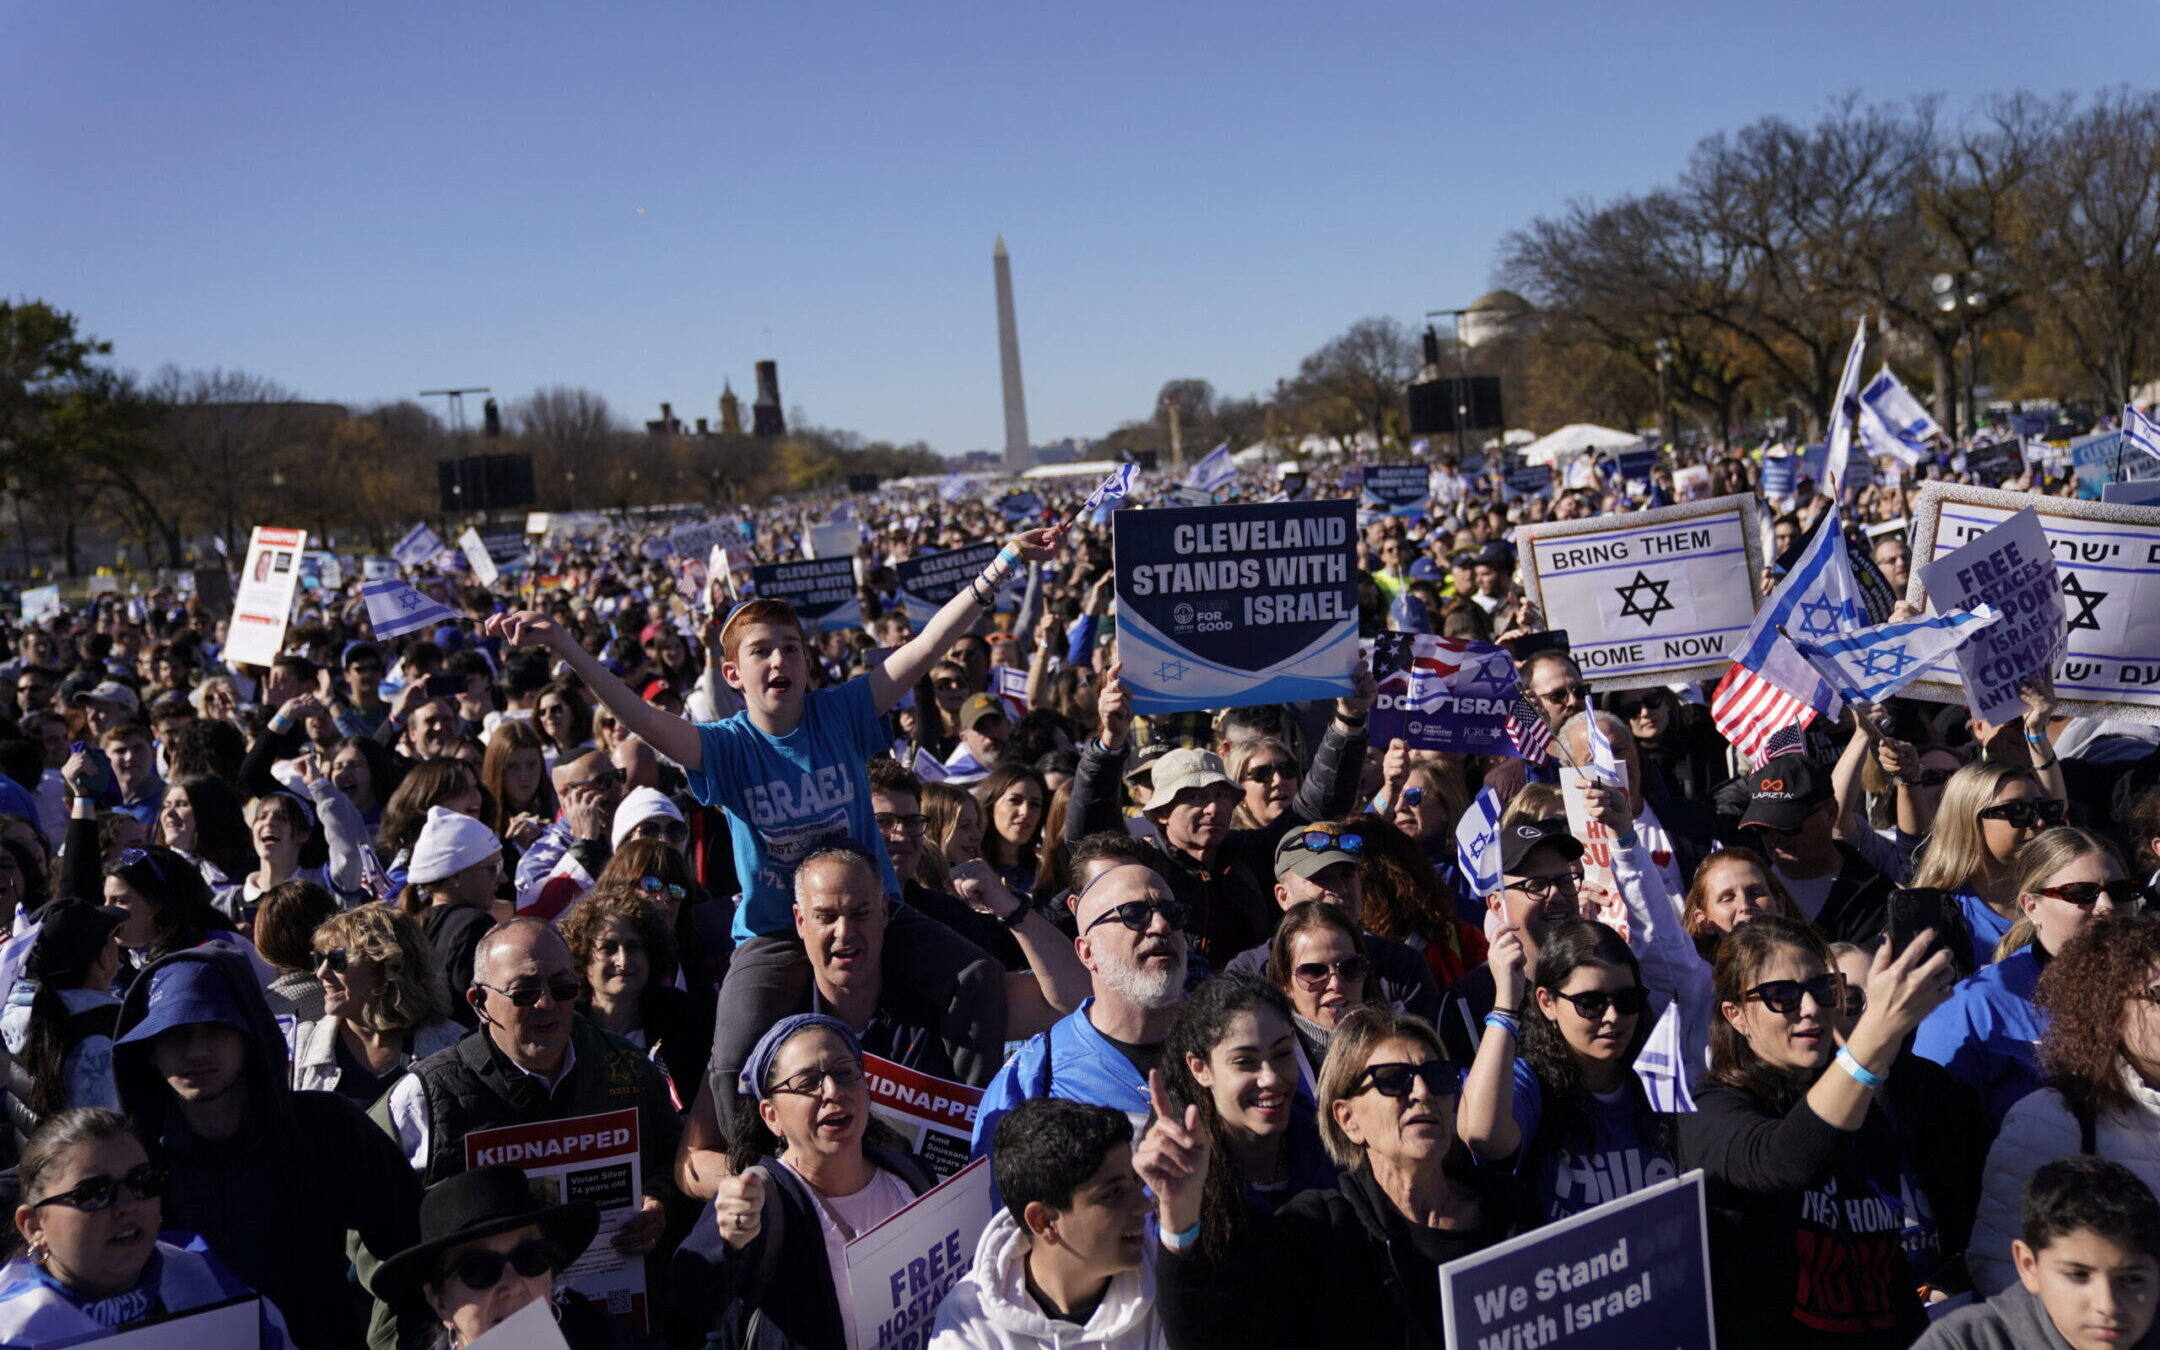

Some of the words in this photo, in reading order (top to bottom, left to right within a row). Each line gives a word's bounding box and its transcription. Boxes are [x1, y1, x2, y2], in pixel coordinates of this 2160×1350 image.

[1174, 517, 1346, 555] CLEVELAND
[1552, 542, 1629, 570] BRING
[1640, 530, 1711, 555] THEM
[776, 561, 851, 580] CLEVELAND
[921, 547, 997, 574] CLEVELAND
[1132, 559, 1260, 595] STANDS
[1266, 553, 1347, 587] WITH
[1956, 541, 2024, 594] FREE
[761, 579, 816, 596] STANDS
[816, 575, 852, 590] WITH
[906, 569, 962, 592] STANDS
[1197, 611, 1222, 622] FOR
[1244, 591, 1351, 626] ISRAEL
[1197, 621, 1233, 632] GOOD
[1989, 611, 2050, 654] ISRAEL
[1573, 644, 1645, 668] HOME
[1664, 635, 1724, 659] NOW
[1978, 615, 2065, 688] COMBAT
[1453, 698, 1515, 716] ISRA
[1463, 726, 1490, 738] JCRC
[743, 763, 855, 825] ISRAEL
[1752, 791, 1793, 799] LAPIZTA
[864, 1072, 980, 1122] IDNAPPE
[476, 1128, 630, 1167] KIDNAPPED
[927, 1142, 969, 1161] Soussana
[929, 1134, 950, 1145] Amit
[571, 1174, 599, 1185] Vivian
[601, 1169, 627, 1181] Silver
[924, 1152, 935, 1160] 40
[936, 1155, 960, 1169] years
[1555, 1148, 1677, 1204] Hille
[571, 1186, 583, 1195] 74
[584, 1184, 609, 1195] years
[611, 1179, 626, 1190] old
[890, 1229, 962, 1310] FREE
[1474, 1284, 1528, 1325] We
[1534, 1237, 1629, 1302] Stand
[1478, 1313, 1558, 1350] With
[1564, 1271, 1652, 1335] Israel
